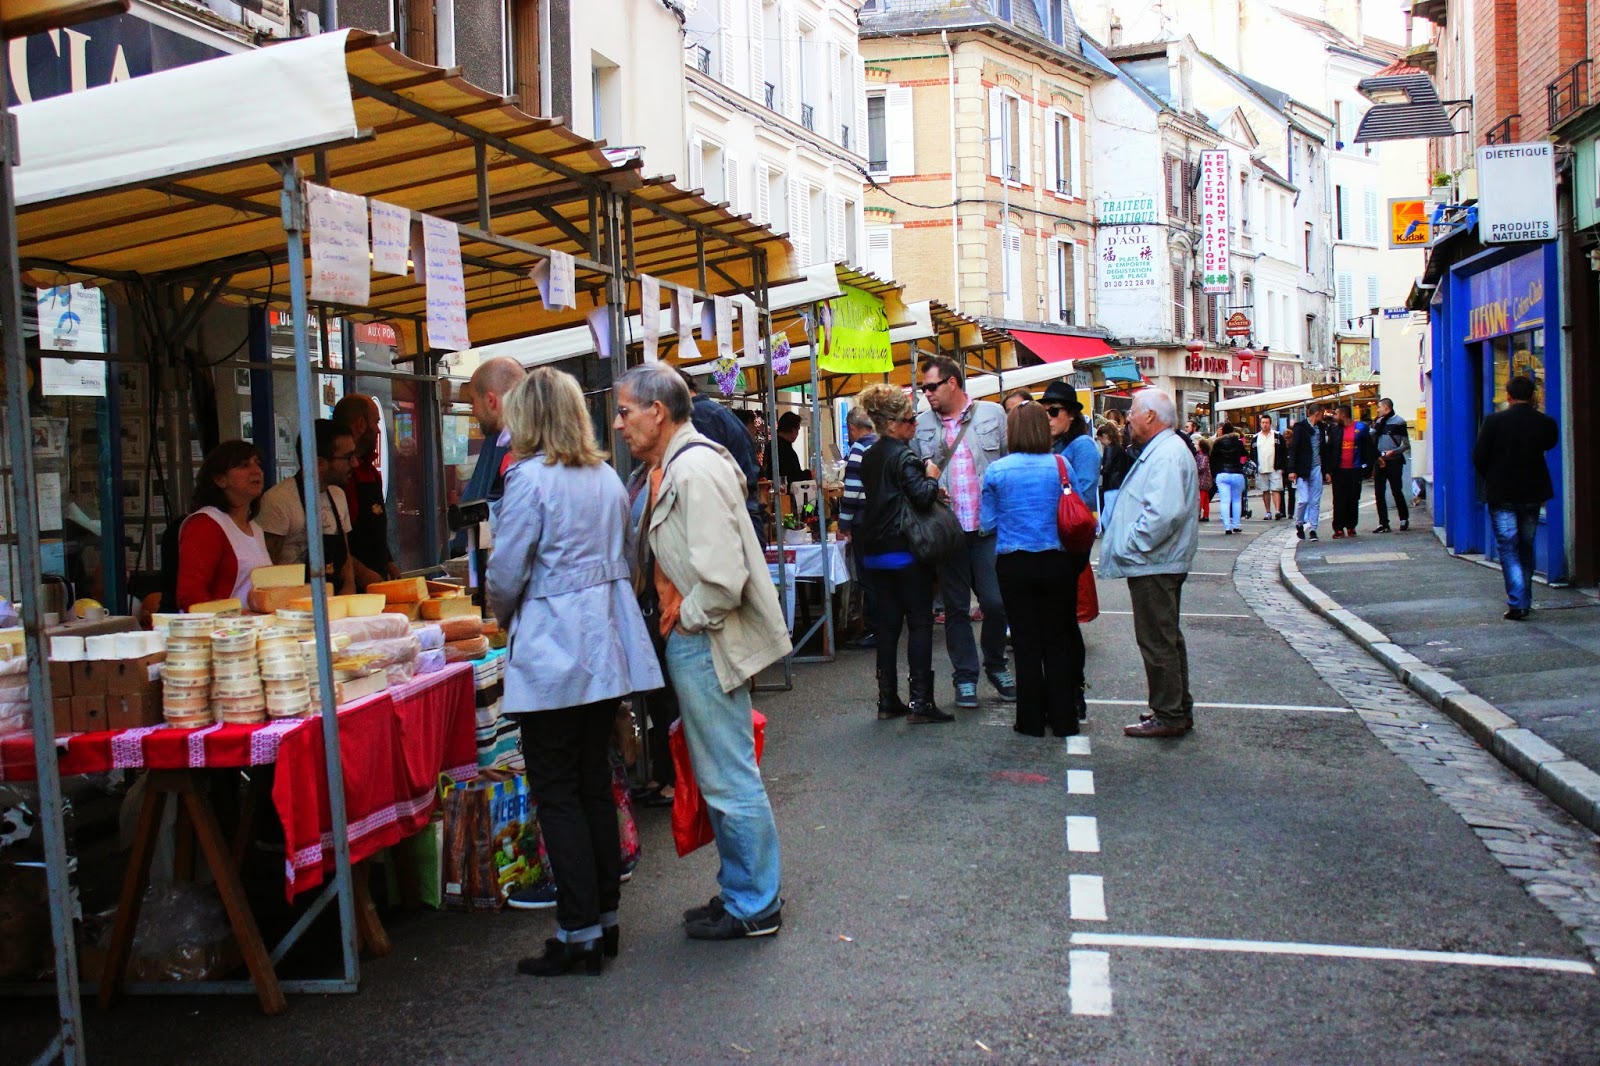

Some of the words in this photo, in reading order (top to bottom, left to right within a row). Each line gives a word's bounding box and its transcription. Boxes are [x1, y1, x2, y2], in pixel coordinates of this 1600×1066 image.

[1204, 154, 1214, 206] TRAITEUR
[1216, 154, 1226, 222] RESTAURANT
[1103, 199, 1153, 212] TRAITEUR
[1102, 211, 1154, 224] ASIATIQUE
[1115, 226, 1141, 235] FLO
[1492, 221, 1549, 232] PRODUITS
[1108, 235, 1149, 246] D'ASIE
[1205, 213, 1214, 271] ASIATIQUE
[1493, 230, 1549, 241] NATURELS
[1217, 228, 1227, 271] RAPIDE
[368, 326, 380, 336] AUX
